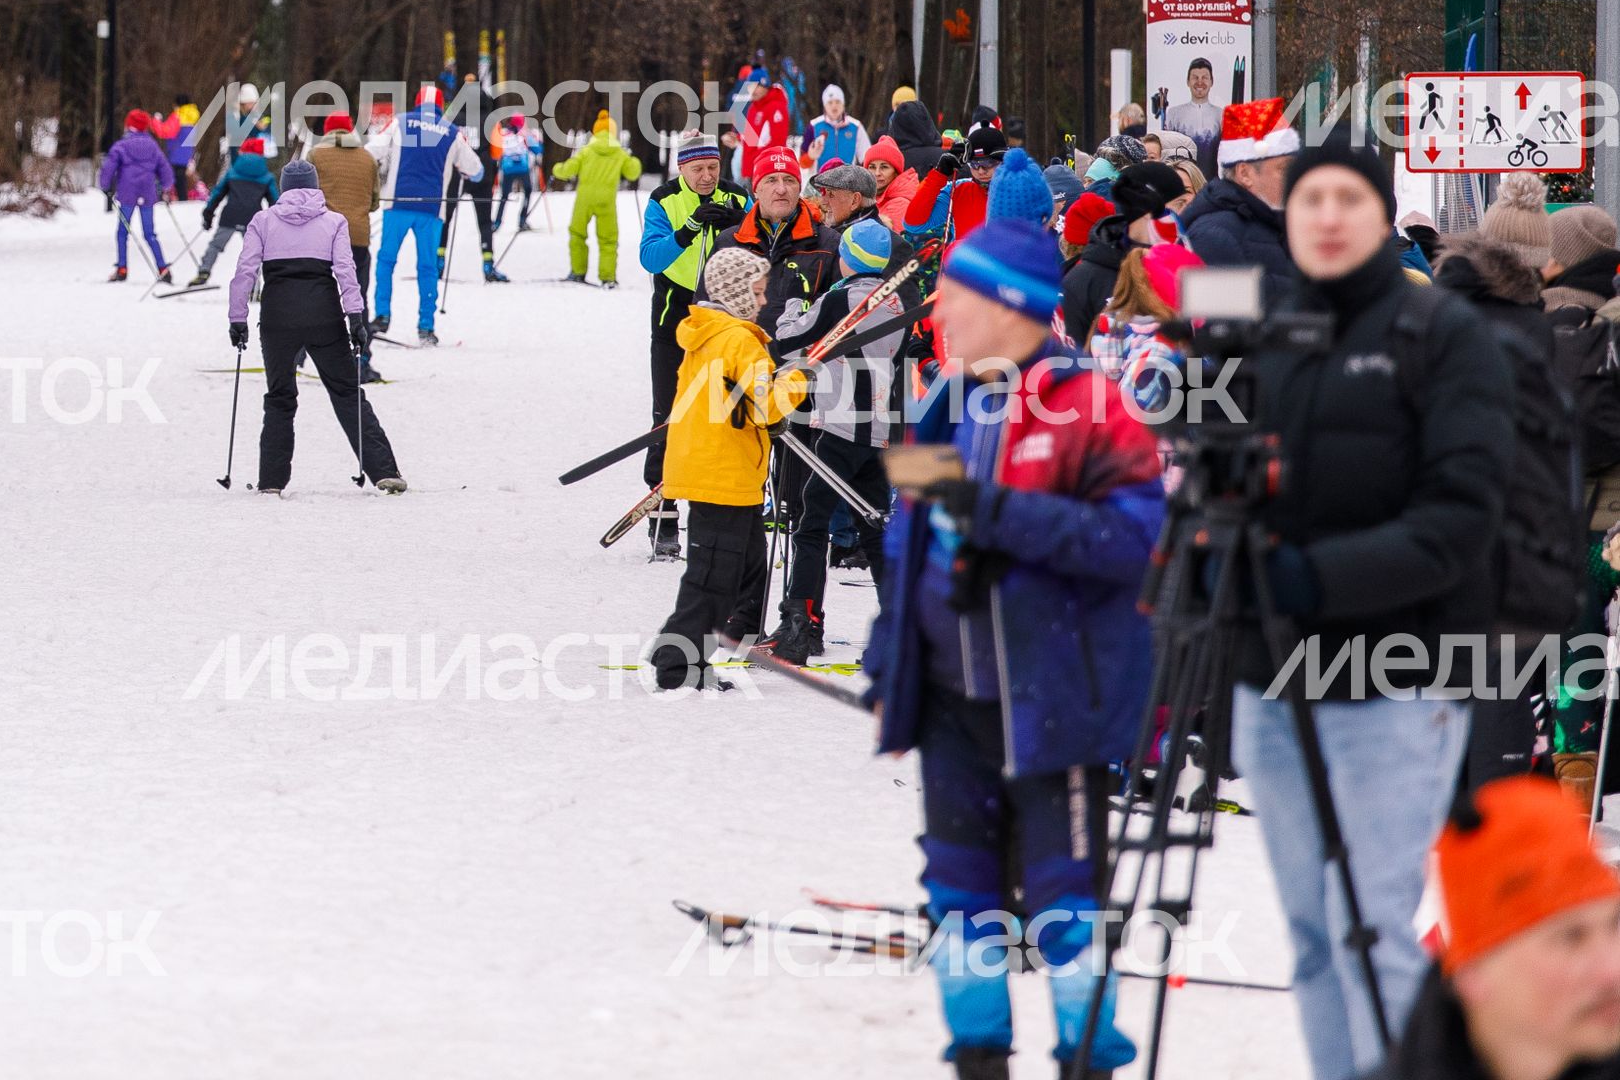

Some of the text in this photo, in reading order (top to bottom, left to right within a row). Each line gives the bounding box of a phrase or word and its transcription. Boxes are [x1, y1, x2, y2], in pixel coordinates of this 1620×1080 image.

[1163, 2, 1231, 11] ОТ 850 РУБЛЕЙ
[1180, 31, 1236, 45] devi club
[867, 259, 920, 311] ATOMIC
